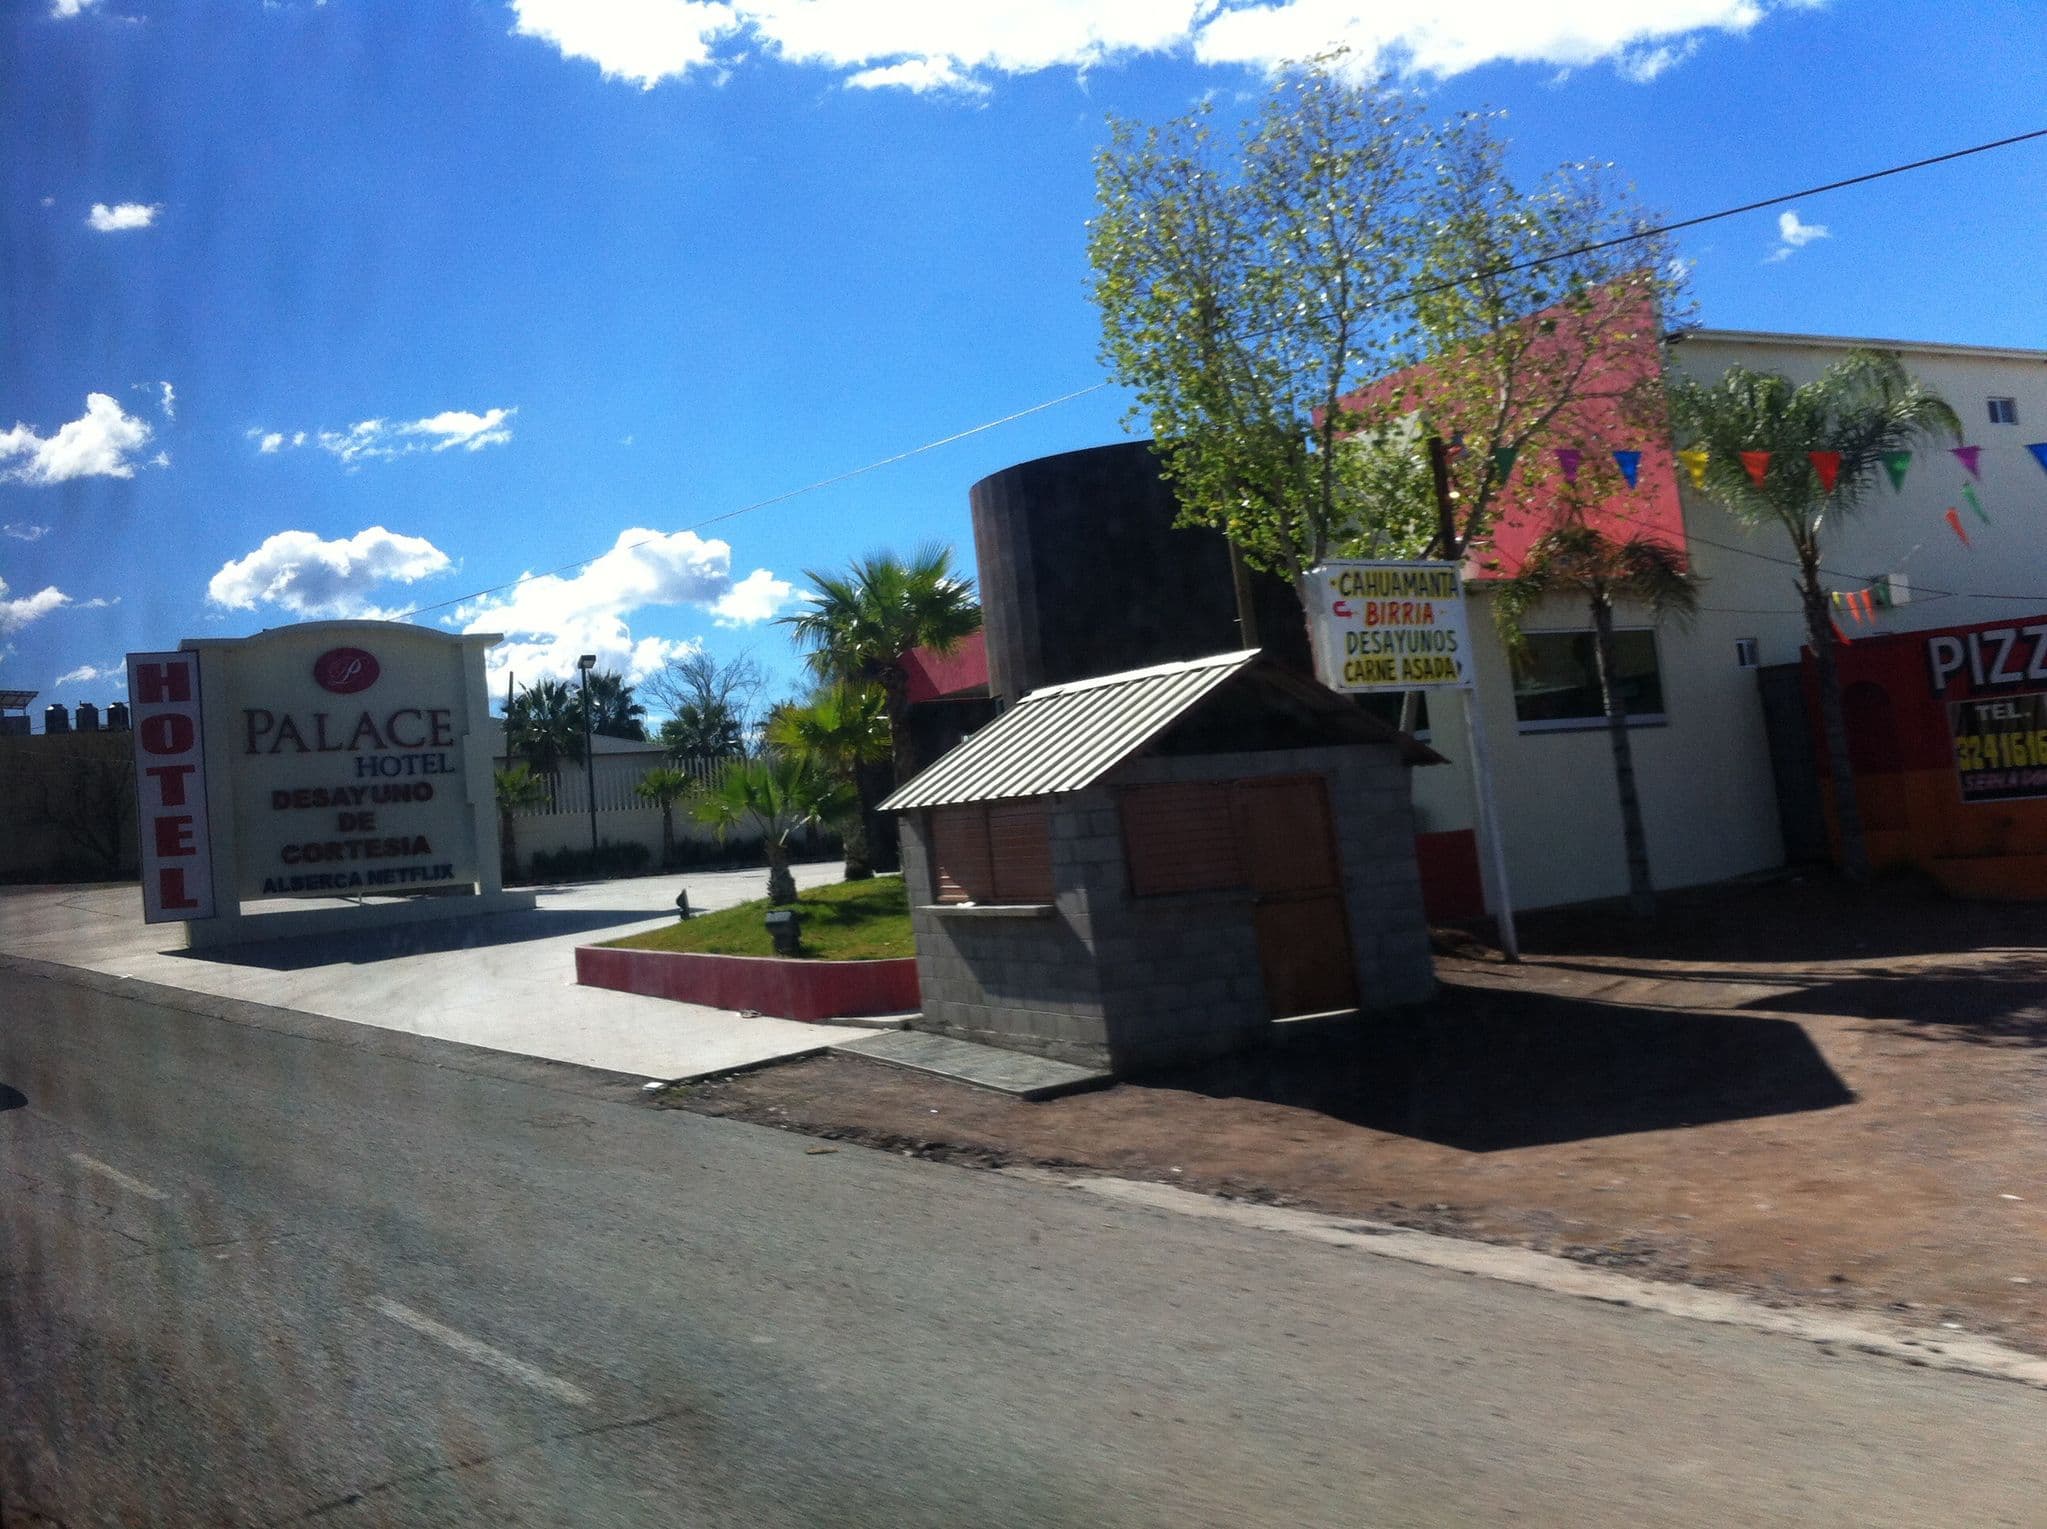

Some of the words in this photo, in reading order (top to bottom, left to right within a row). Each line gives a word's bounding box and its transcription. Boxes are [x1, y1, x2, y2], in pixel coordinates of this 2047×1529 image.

[1339, 570, 1459, 597] CAHUAMANTA
[1365, 601, 1435, 626] BIRRIA
[1345, 629, 1458, 655] DESAYUNOS
[1344, 658, 1397, 682] CARNE
[1402, 657, 1458, 681] ASADA
[1974, 702, 2032, 720] TEL.
[243, 708, 454, 754] PALACE
[355, 752, 456, 779] HOTEL
[137, 662, 198, 910] HOTEL
[272, 781, 434, 811] DESAYUNO
[338, 811, 377, 833] DE
[281, 834, 432, 865] CORTESIA
[263, 871, 363, 894] ALBERCA
[367, 863, 456, 886] NETFLIX
